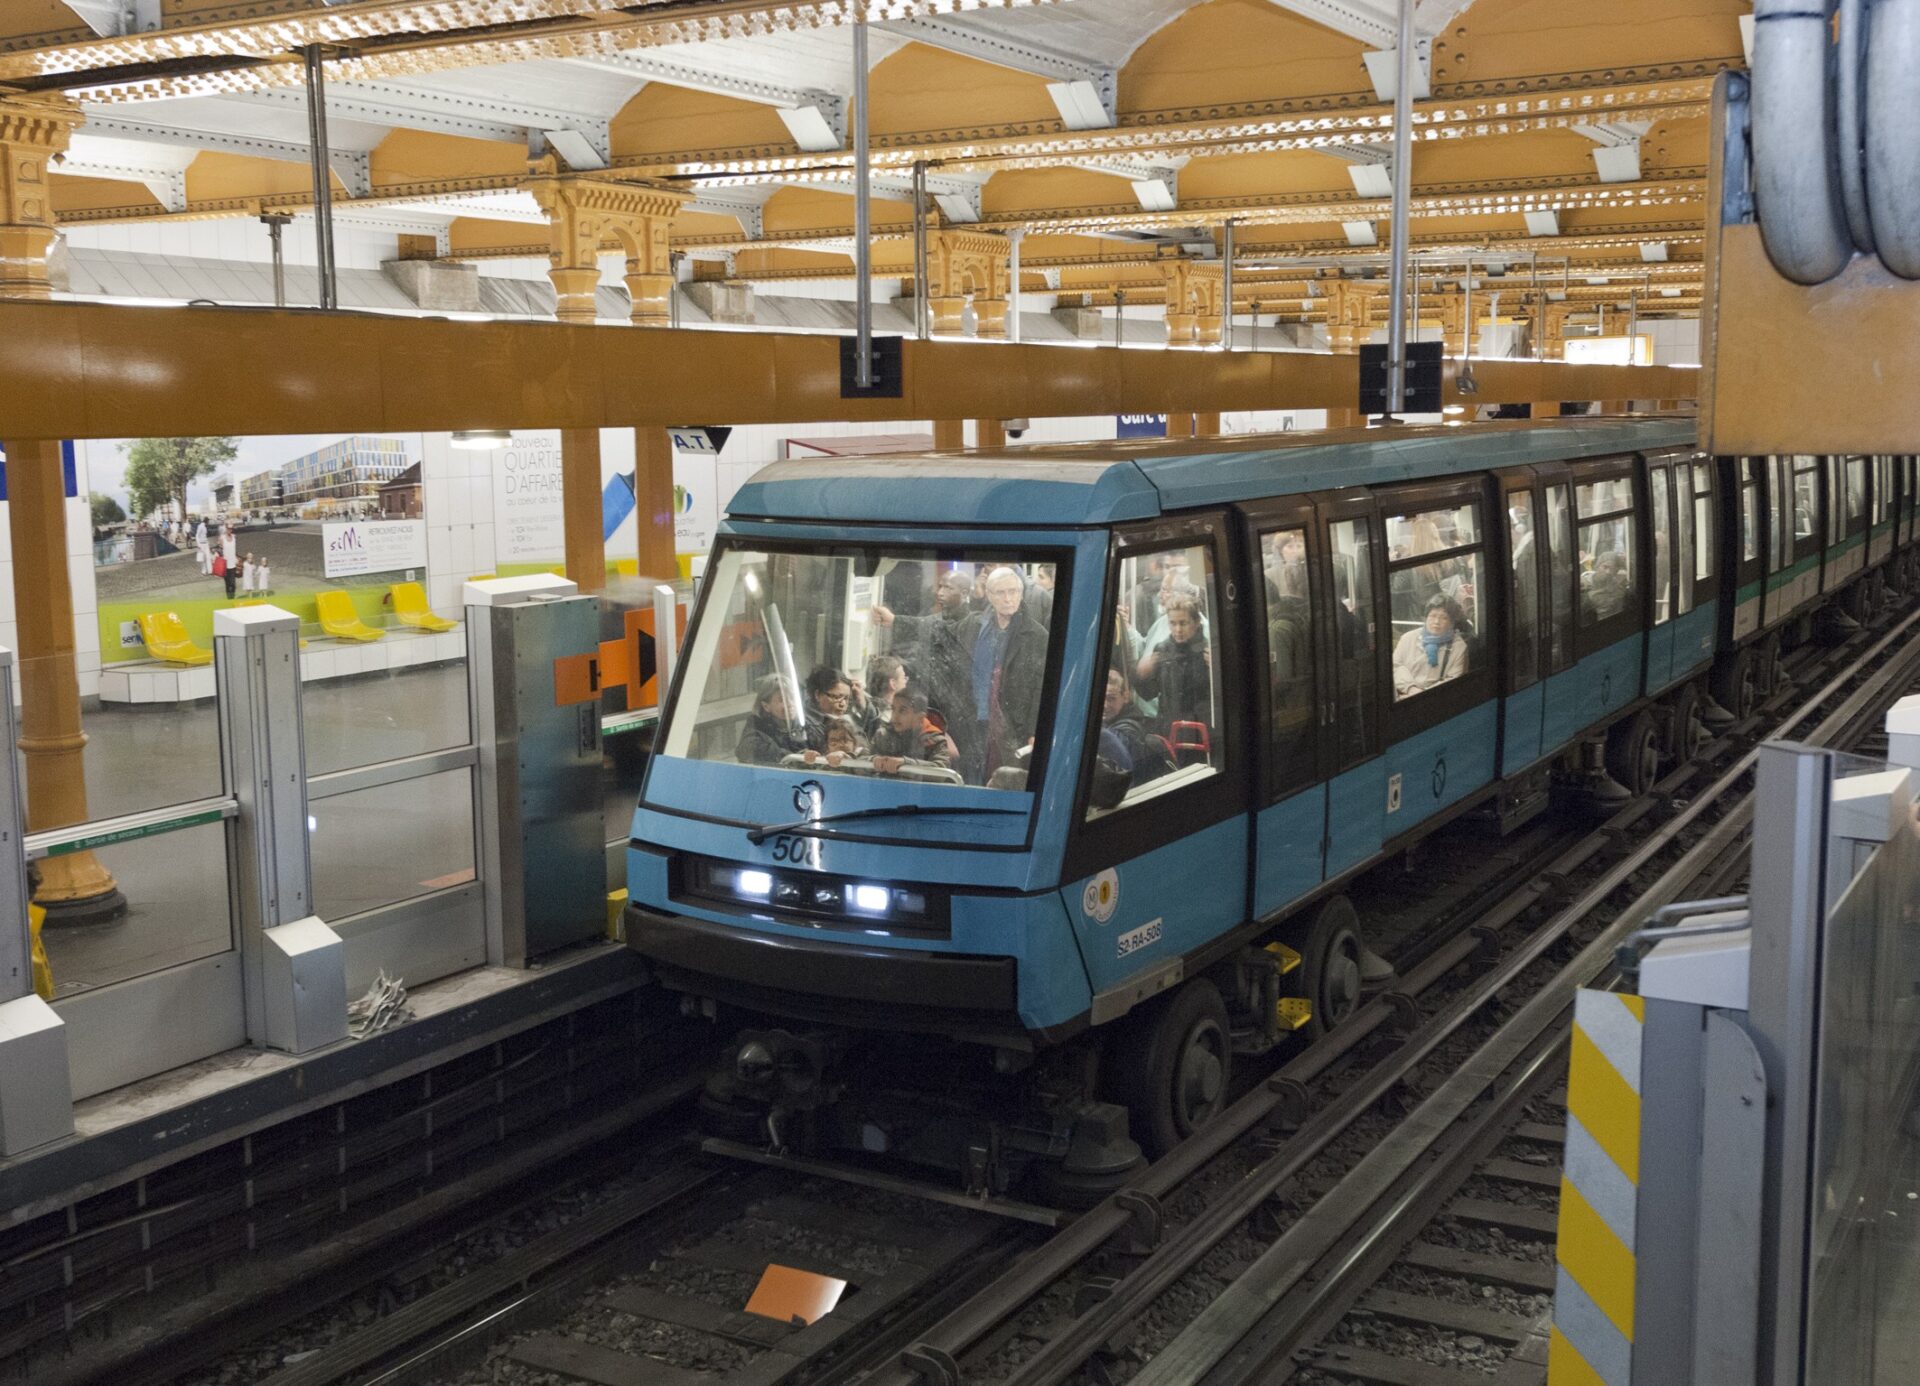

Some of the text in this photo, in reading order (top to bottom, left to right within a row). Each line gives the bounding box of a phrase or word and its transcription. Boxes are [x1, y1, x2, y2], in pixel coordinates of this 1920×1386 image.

[674, 434, 714, 450] A.T.
[504, 450, 562, 473] QUARTIE
[505, 473, 562, 494] D'AFFAIRE
